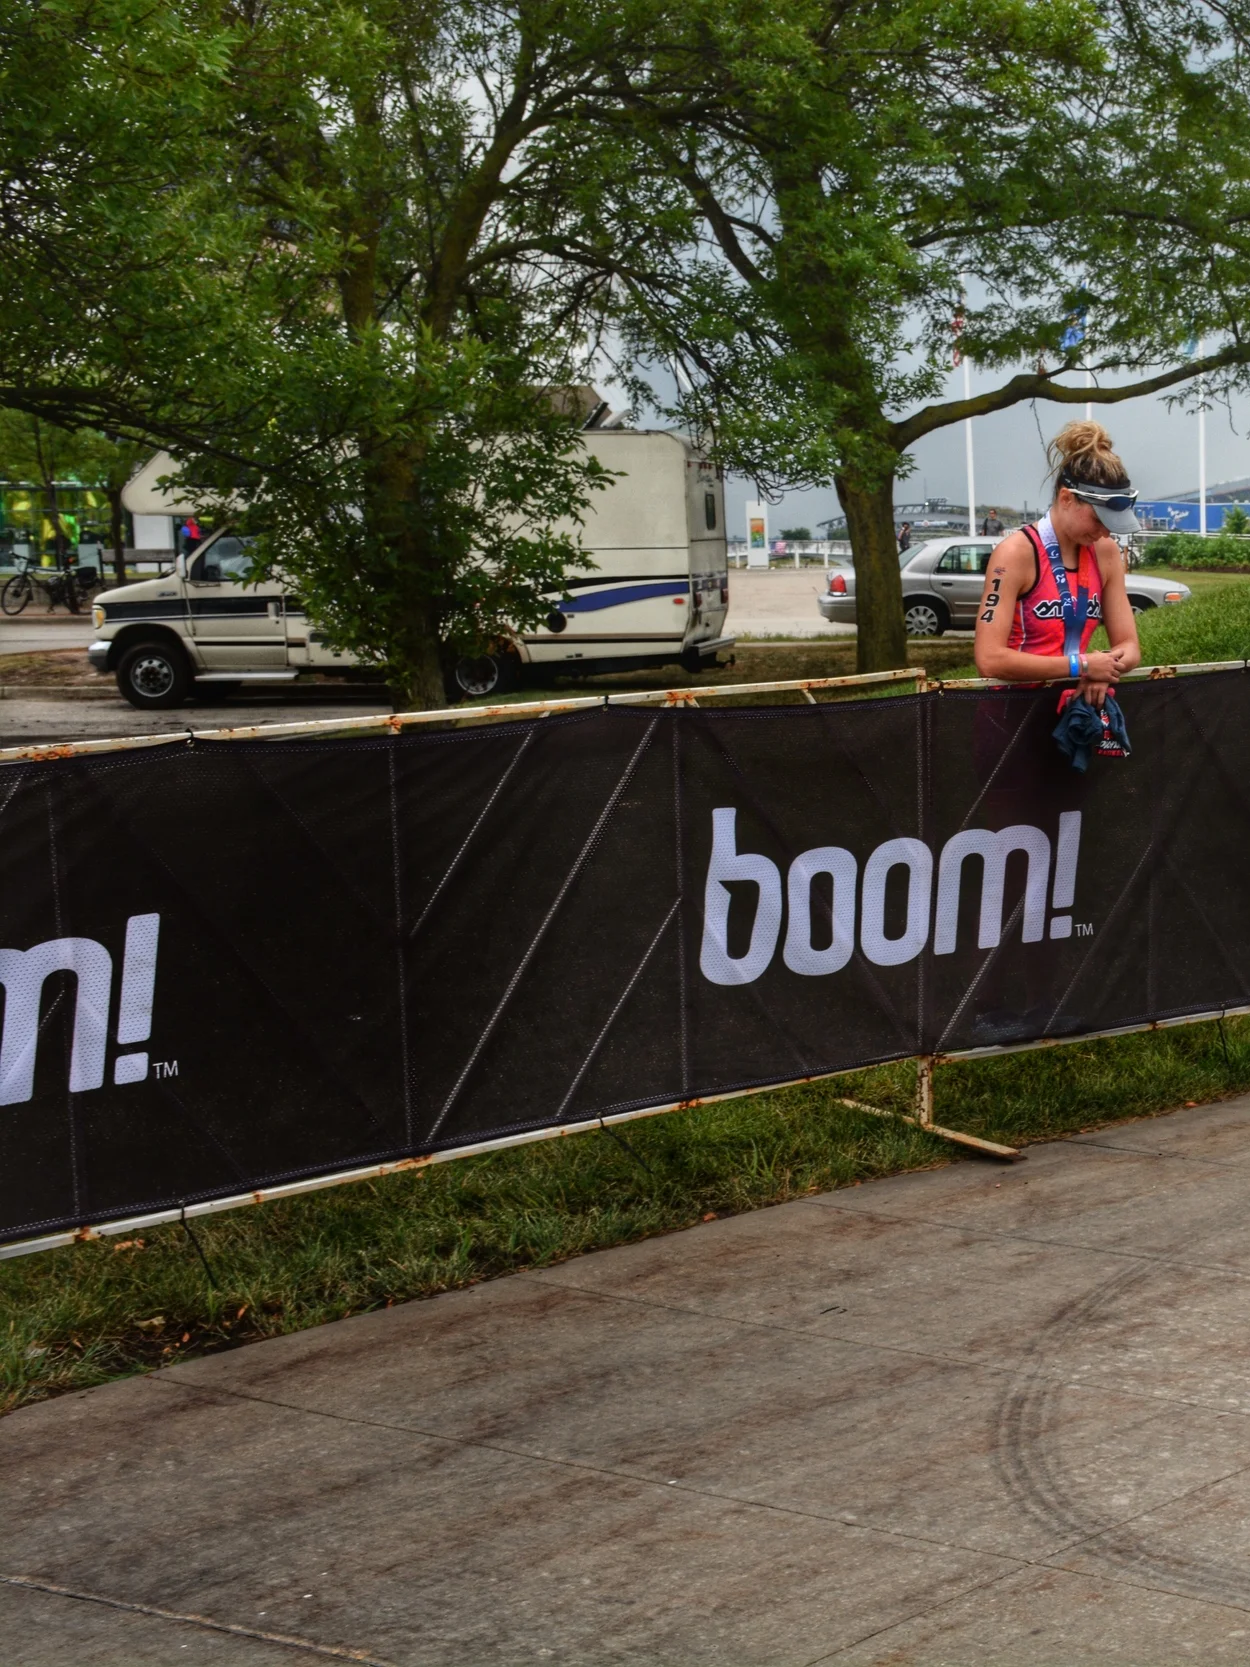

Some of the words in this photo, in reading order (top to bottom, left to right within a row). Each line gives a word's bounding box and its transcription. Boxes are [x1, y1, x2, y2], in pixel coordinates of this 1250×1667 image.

[980, 579, 1001, 623] 194
[700, 807, 1082, 986] boom!
[1075, 923, 1094, 938] TM
[152, 1060, 179, 1079] TM
